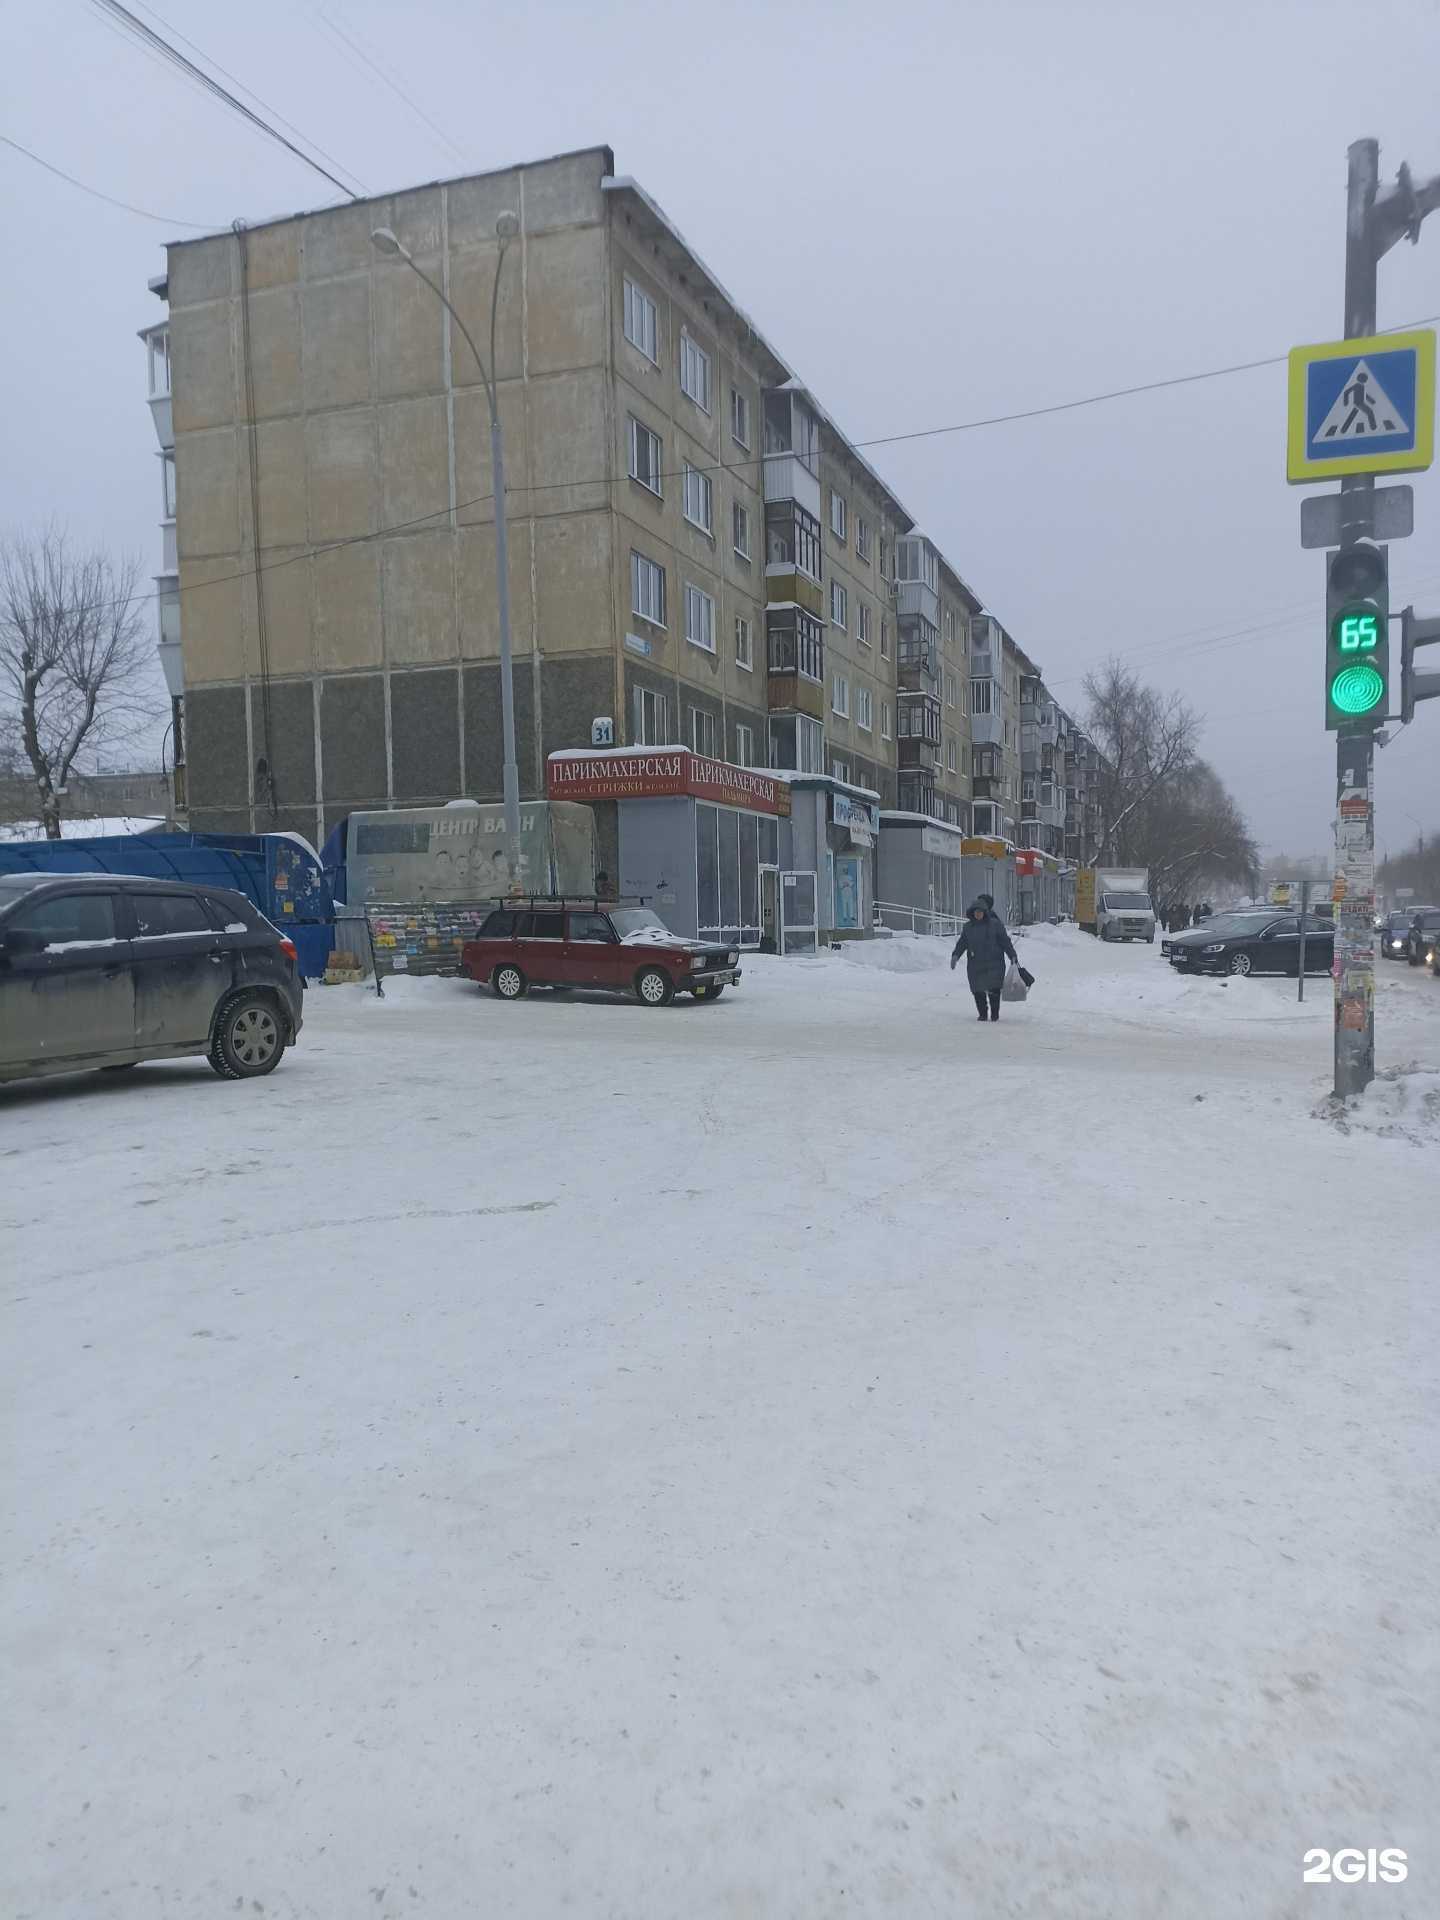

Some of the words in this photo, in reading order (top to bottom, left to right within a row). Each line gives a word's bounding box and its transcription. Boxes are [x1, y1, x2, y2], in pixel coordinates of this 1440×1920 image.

[1341, 617, 1377, 649] 65
[595, 726, 610, 742] 31
[552, 756, 681, 783] ПАРИКМАХЕРСКАЯ
[690, 758, 775, 803] ПАРИКМАХЕРСКАЯ
[589, 781, 643, 794] СТРИЖКИ
[483, 815, 536, 834] ВАН
